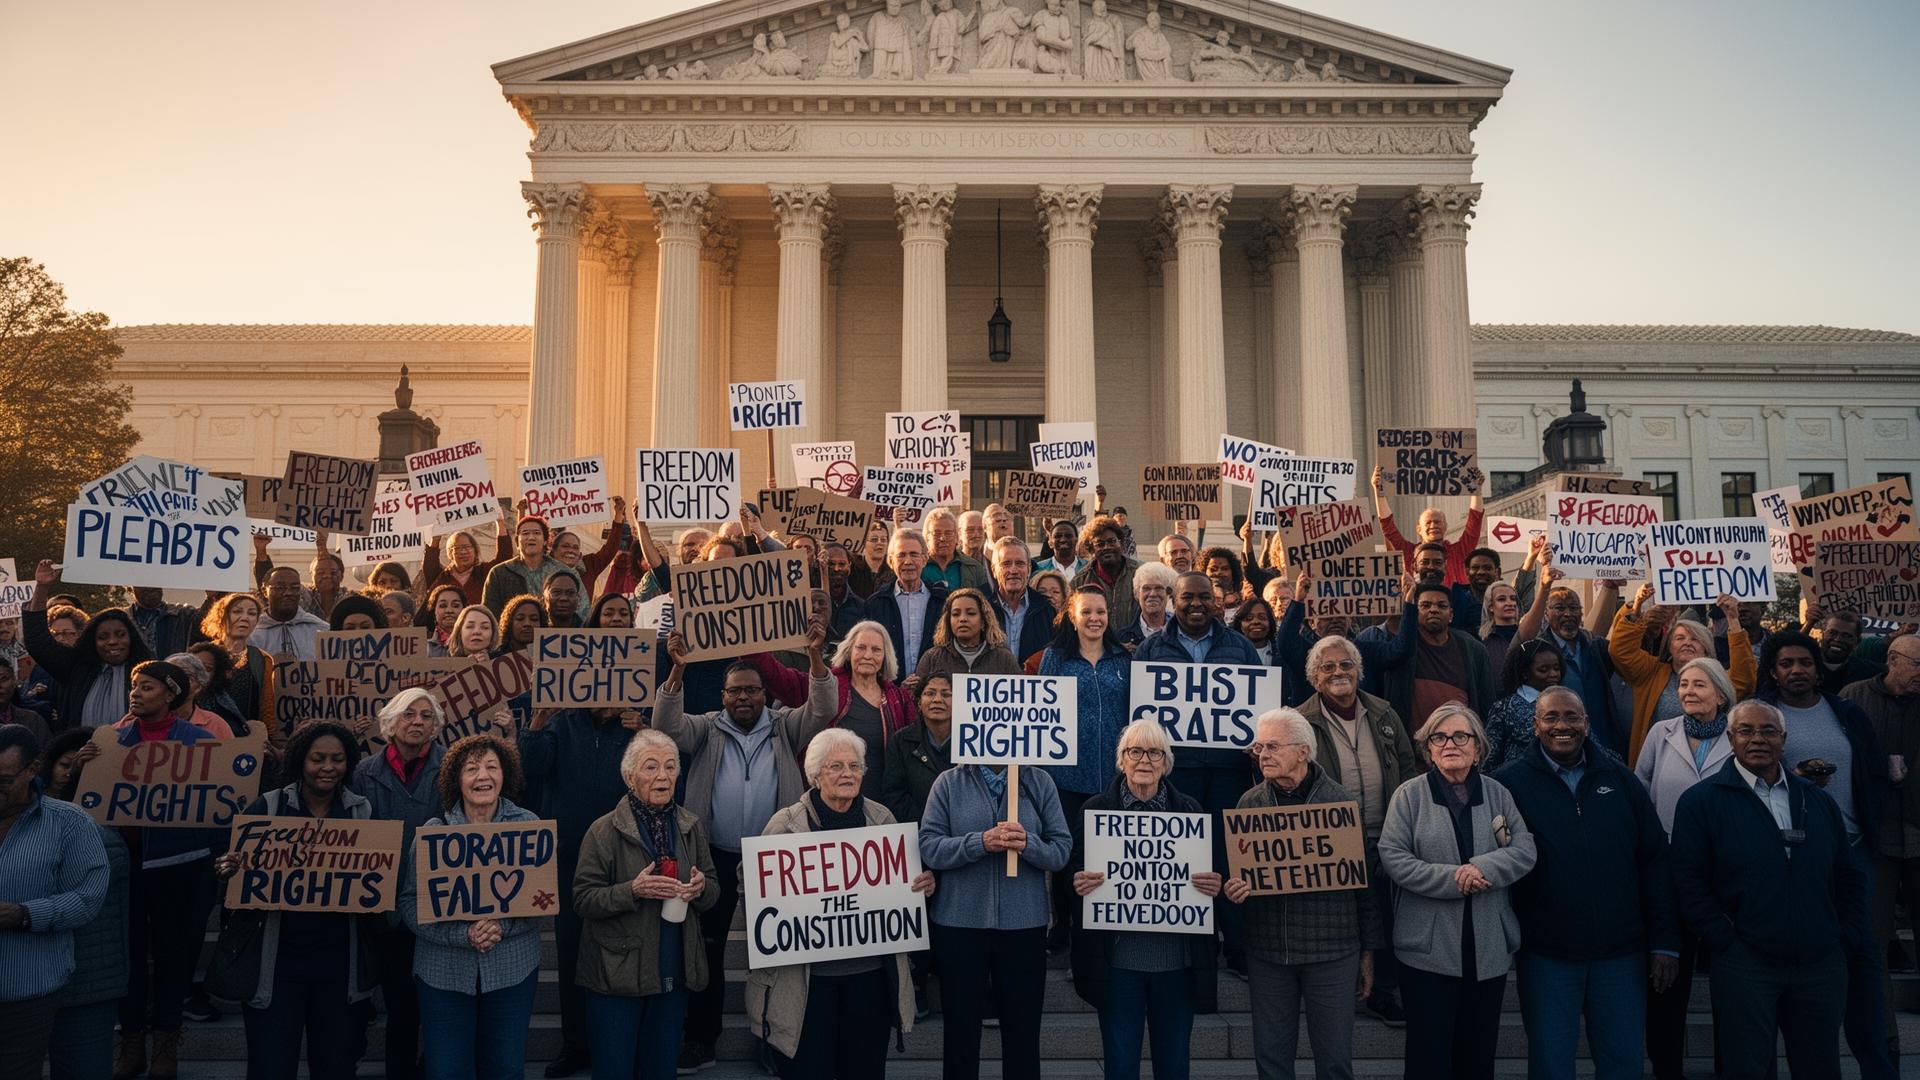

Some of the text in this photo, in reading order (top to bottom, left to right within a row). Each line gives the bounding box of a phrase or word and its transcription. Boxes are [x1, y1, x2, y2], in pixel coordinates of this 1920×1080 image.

[289, 454, 376, 489] FREEDOM
[640, 451, 734, 482] FREEDOM
[413, 480, 495, 516] FREEDOM
[645, 485, 730, 520] RIGHTS
[77, 509, 240, 569] PLEABTS
[373, 517, 394, 533] THE
[1659, 565, 1769, 602] FREEDOM
[536, 667, 650, 703] RIGHTS
[967, 677, 1057, 704] RIGHTS
[1146, 665, 1267, 705] BHST
[959, 723, 1068, 760] RIGHTS
[106, 783, 236, 826] RIGHTS
[1094, 814, 1204, 839] FREEDOM
[422, 828, 553, 871] TORATED
[757, 834, 908, 898] FREEDOM
[240, 869, 384, 909] RIGHTS
[1107, 862, 1190, 881] PONTOM
[820, 893, 860, 914] THE
[1092, 902, 1210, 927] FEIVEDOOY
